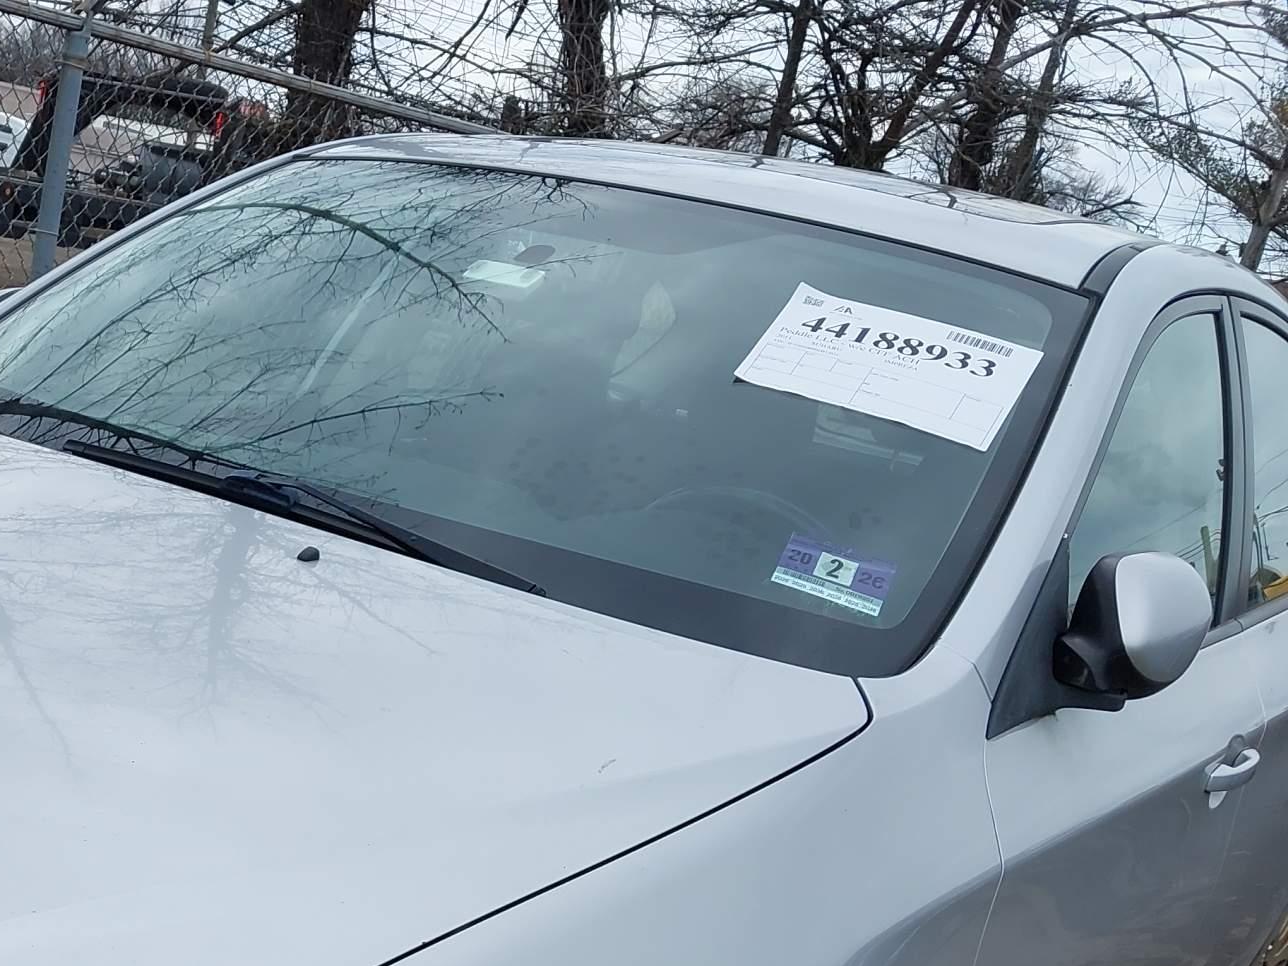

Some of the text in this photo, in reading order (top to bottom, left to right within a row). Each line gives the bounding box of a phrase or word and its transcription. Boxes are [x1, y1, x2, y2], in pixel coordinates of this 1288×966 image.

[800, 317, 997, 378] 44188933
[788, 549, 813, 565] 20
[825, 559, 844, 579] 2
